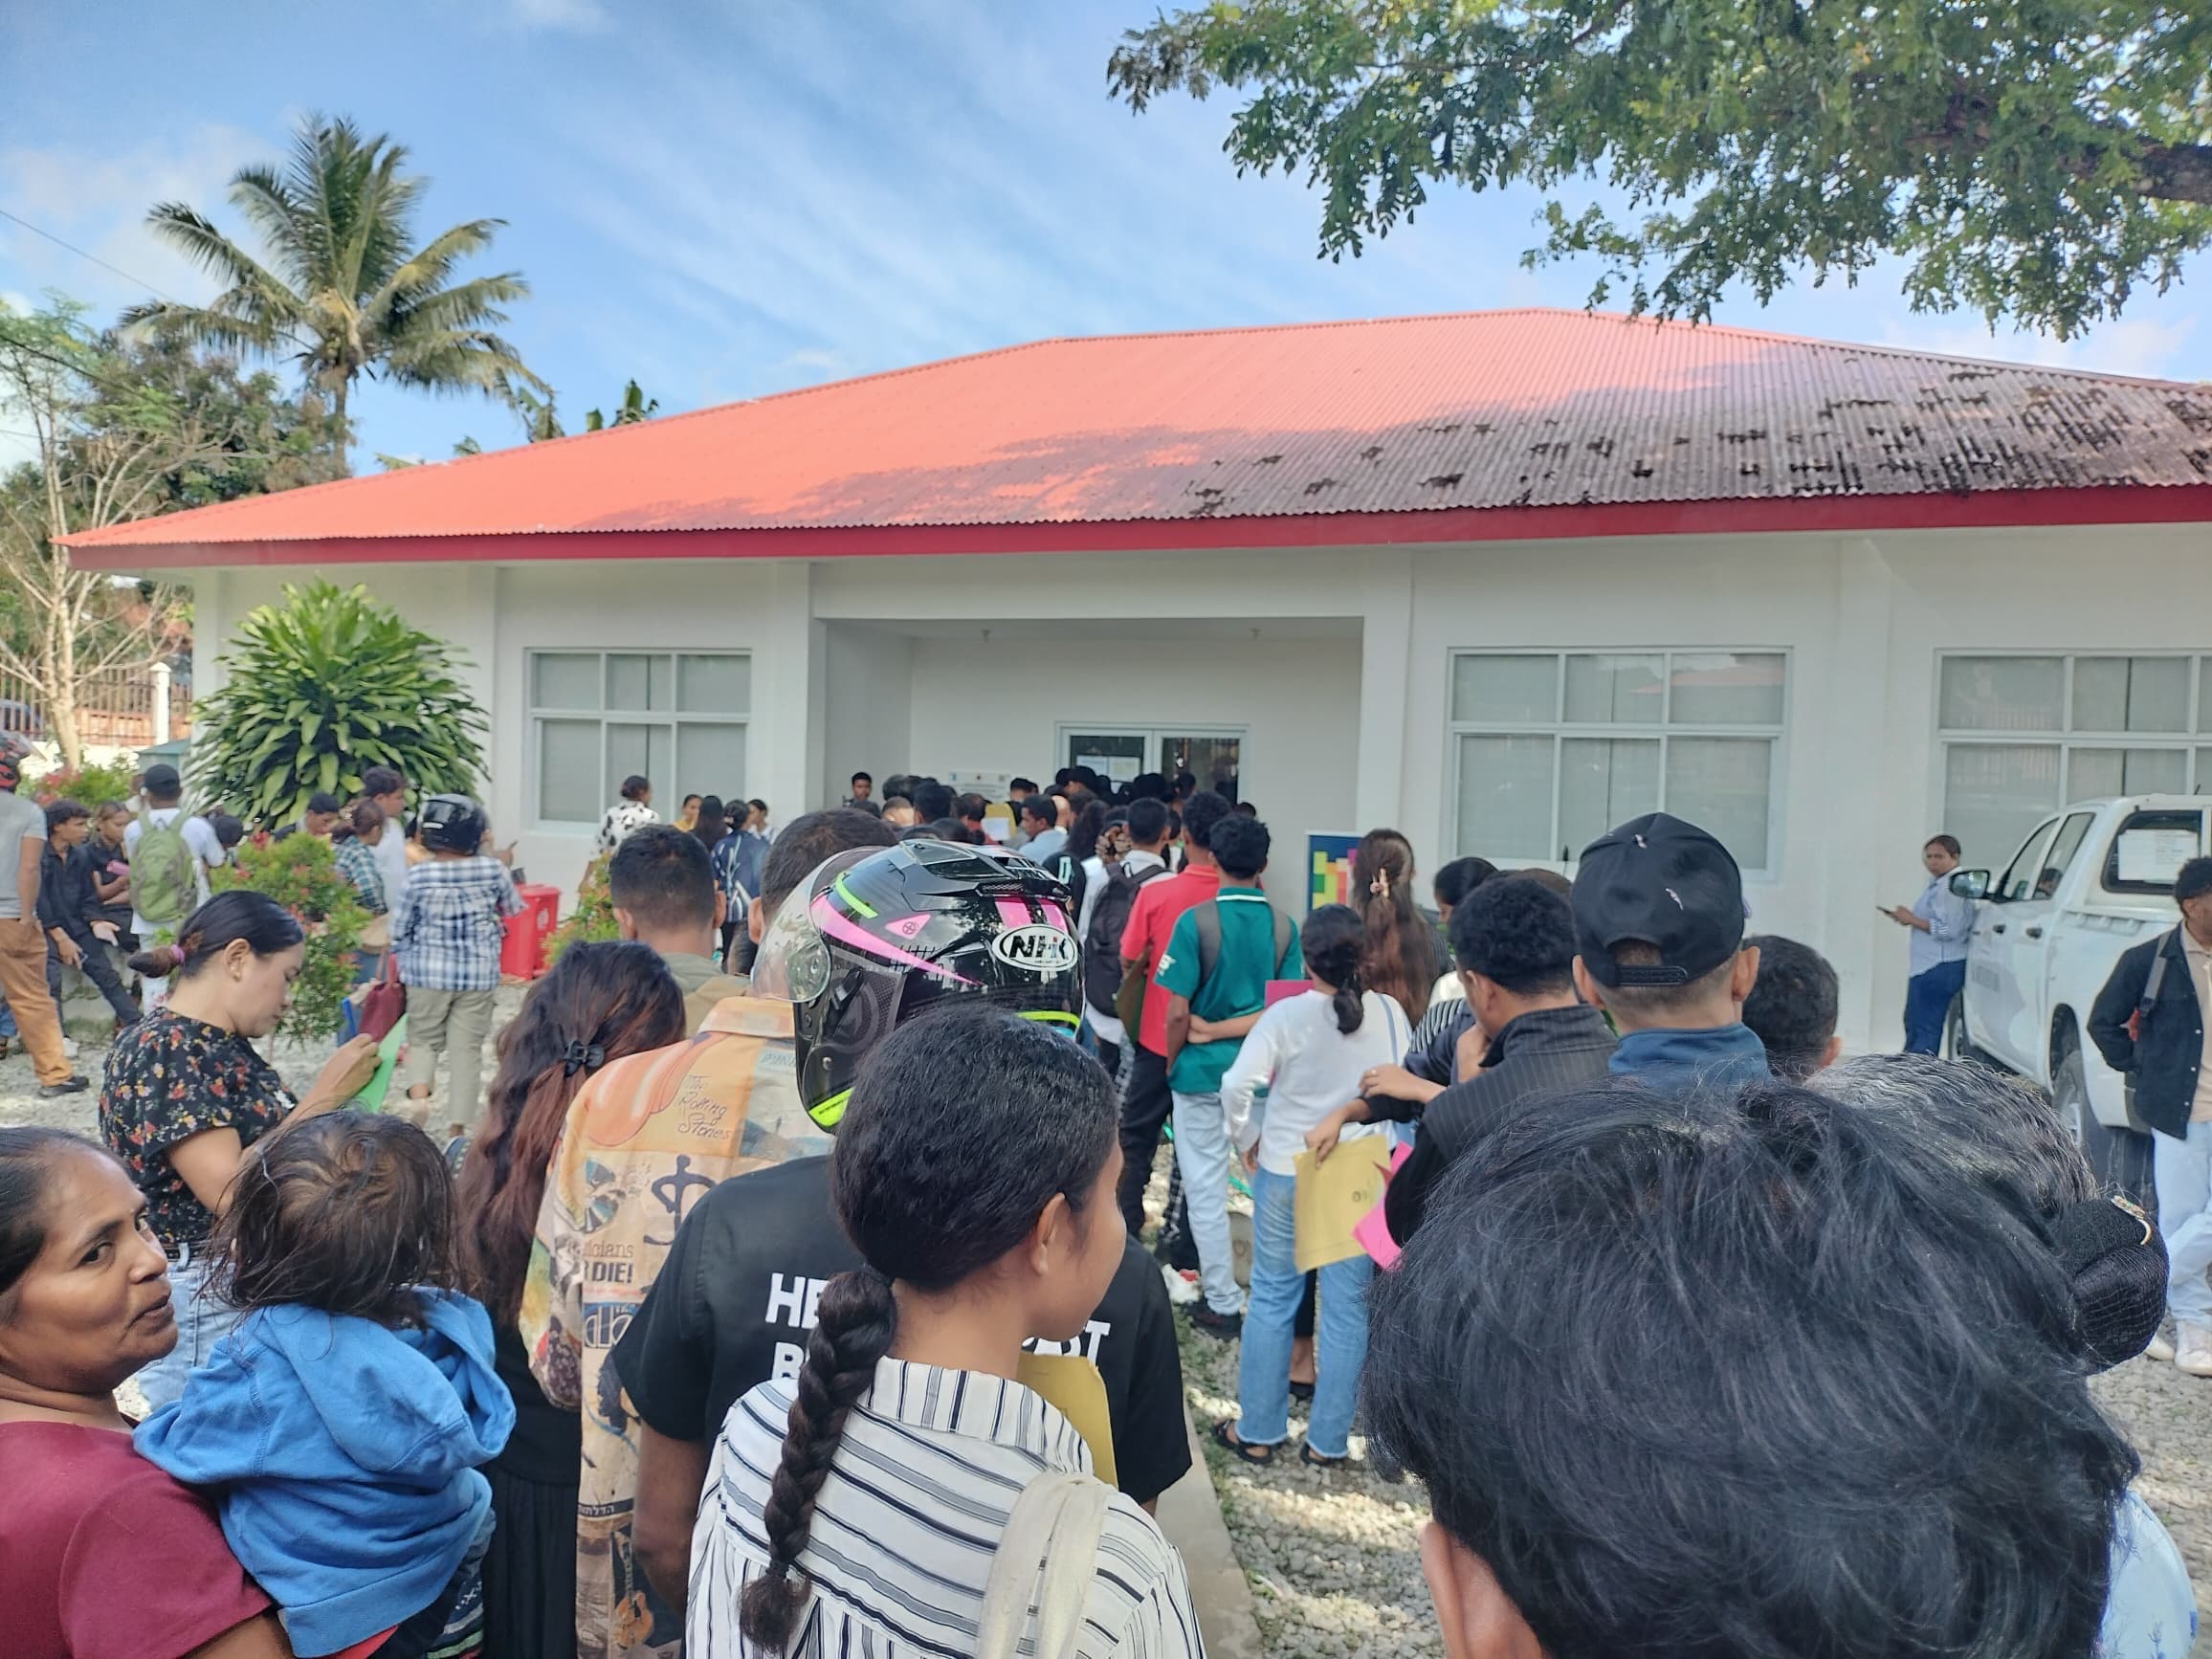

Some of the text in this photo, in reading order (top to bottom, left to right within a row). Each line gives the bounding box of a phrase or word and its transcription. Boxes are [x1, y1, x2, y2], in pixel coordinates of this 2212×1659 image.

[1009, 935, 1069, 960] NHK
[591, 1261, 633, 1283] DIE!
[765, 1272, 830, 1329] HE
